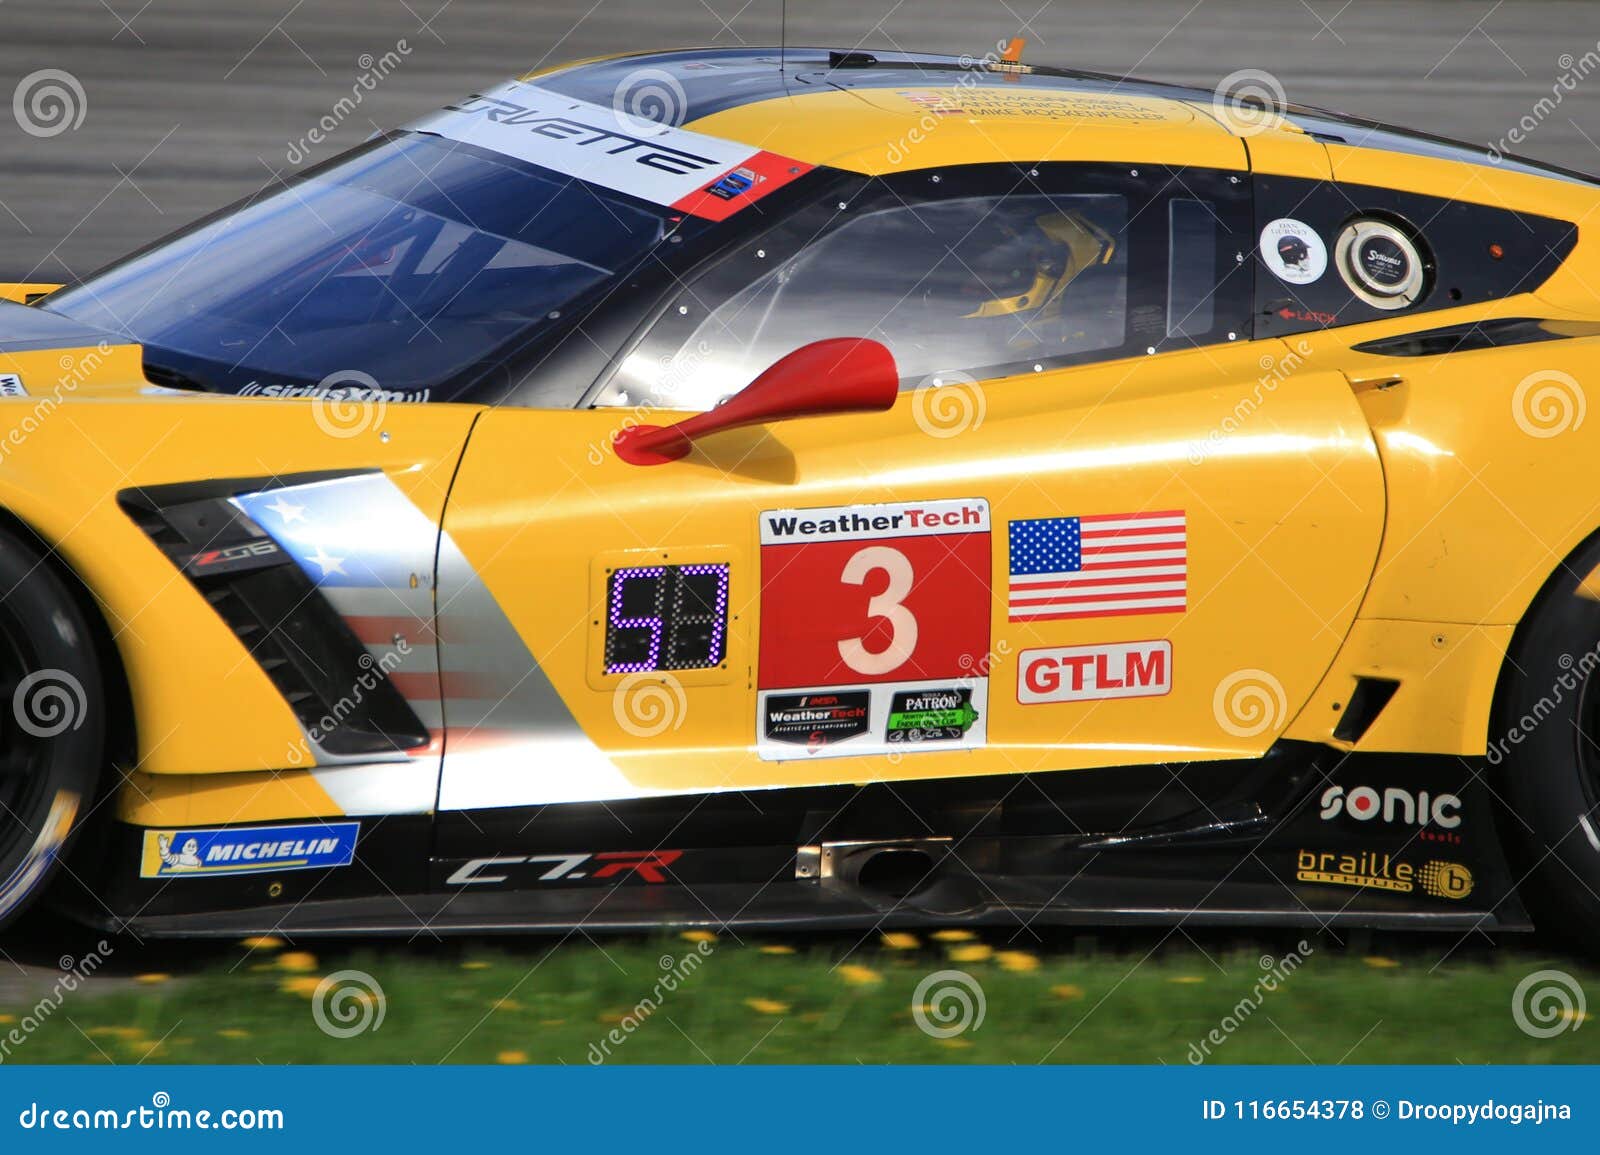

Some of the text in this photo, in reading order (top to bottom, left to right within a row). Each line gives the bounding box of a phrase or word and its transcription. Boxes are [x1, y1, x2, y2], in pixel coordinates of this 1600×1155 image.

[1296, 310, 1336, 324] LATCH
[837, 545, 919, 676] 3
[1025, 650, 1165, 694] GTLM
[905, 694, 959, 711] PATRÓN
[769, 707, 865, 723] WeatherTech
[205, 837, 340, 862] MICHELIN
[1420, 831, 1462, 845] tools
[446, 850, 684, 885] C7.R
[1298, 849, 1414, 881] braille
[1299, 871, 1412, 892] LITHIUM
